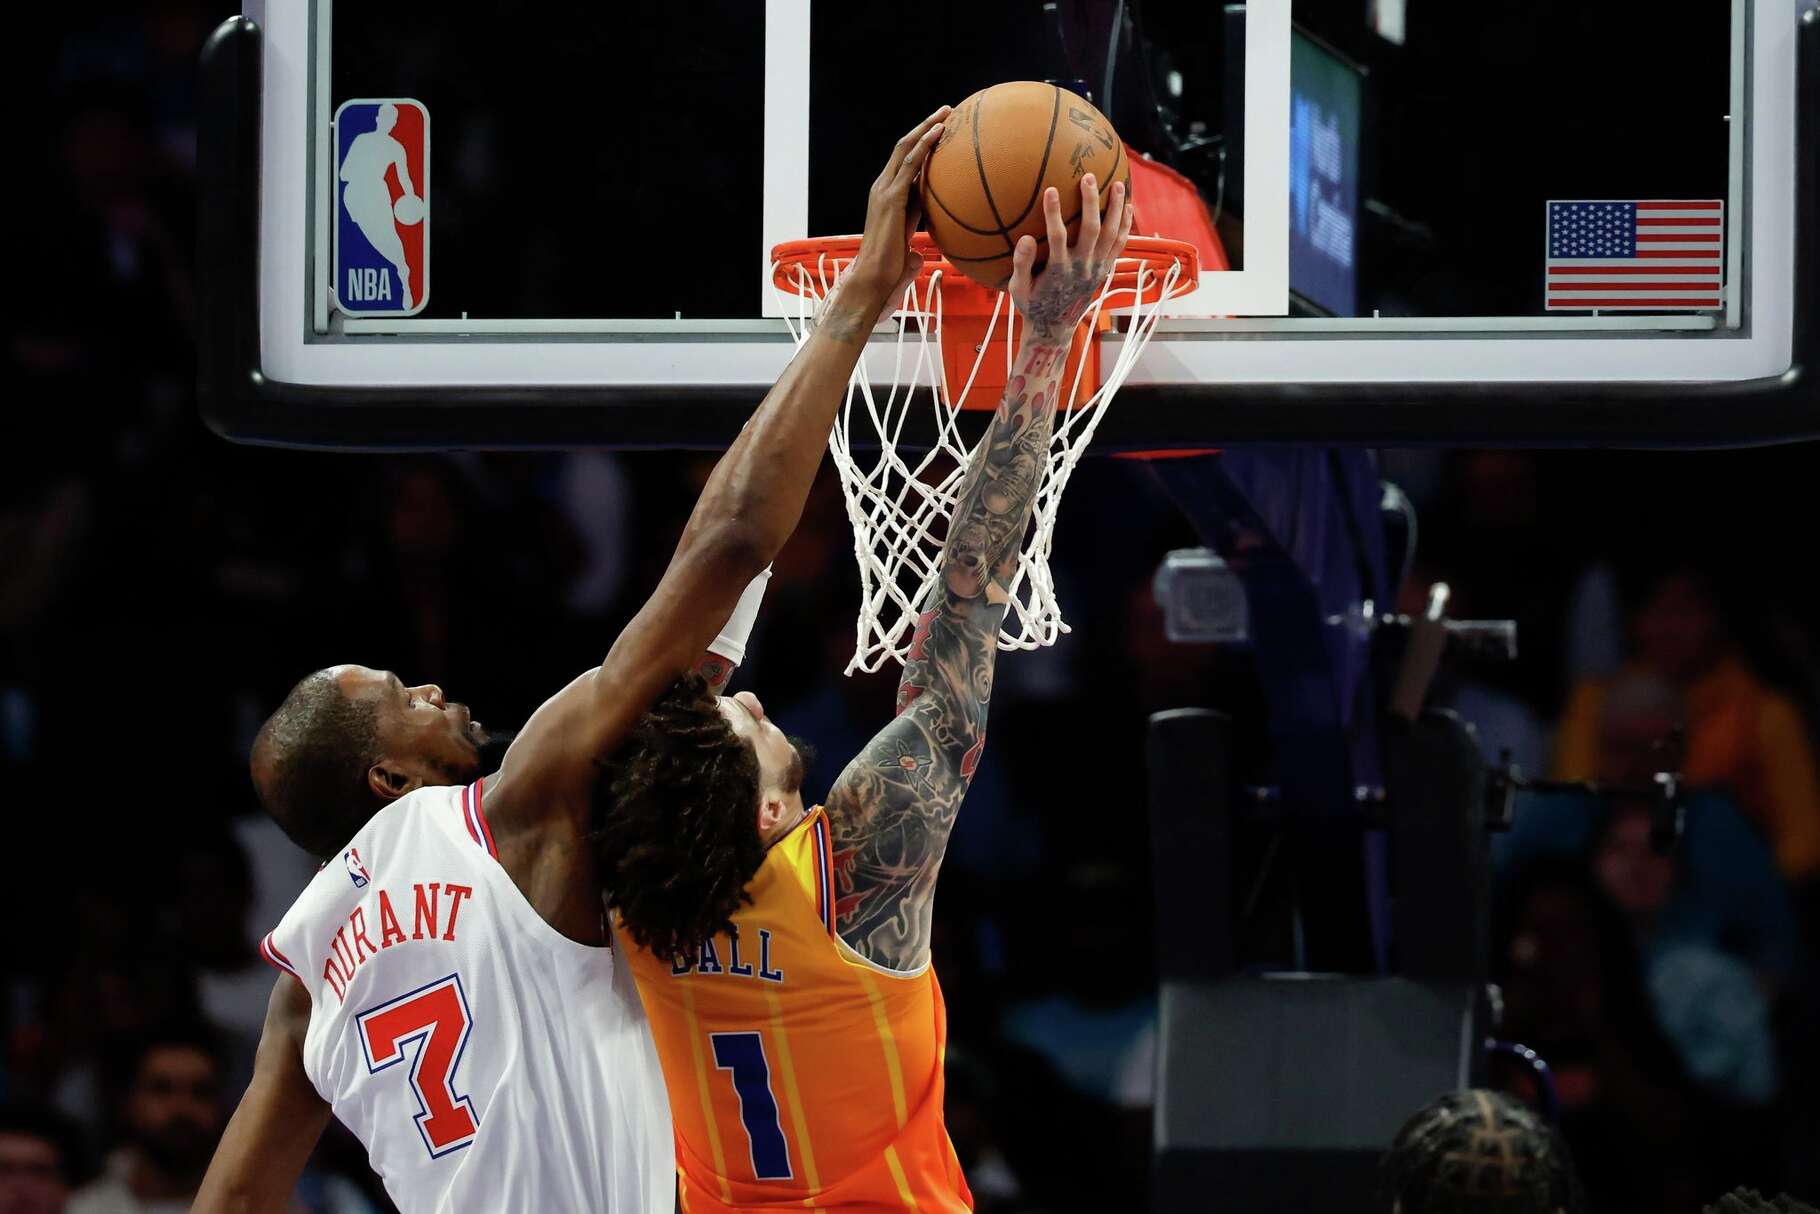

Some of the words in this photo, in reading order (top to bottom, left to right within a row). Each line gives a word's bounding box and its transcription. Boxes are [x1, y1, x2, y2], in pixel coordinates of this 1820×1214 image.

[348, 267, 392, 301] NBA
[323, 882, 473, 1006] DURANT
[355, 972, 481, 1160] 7
[708, 1030, 794, 1181] 1
